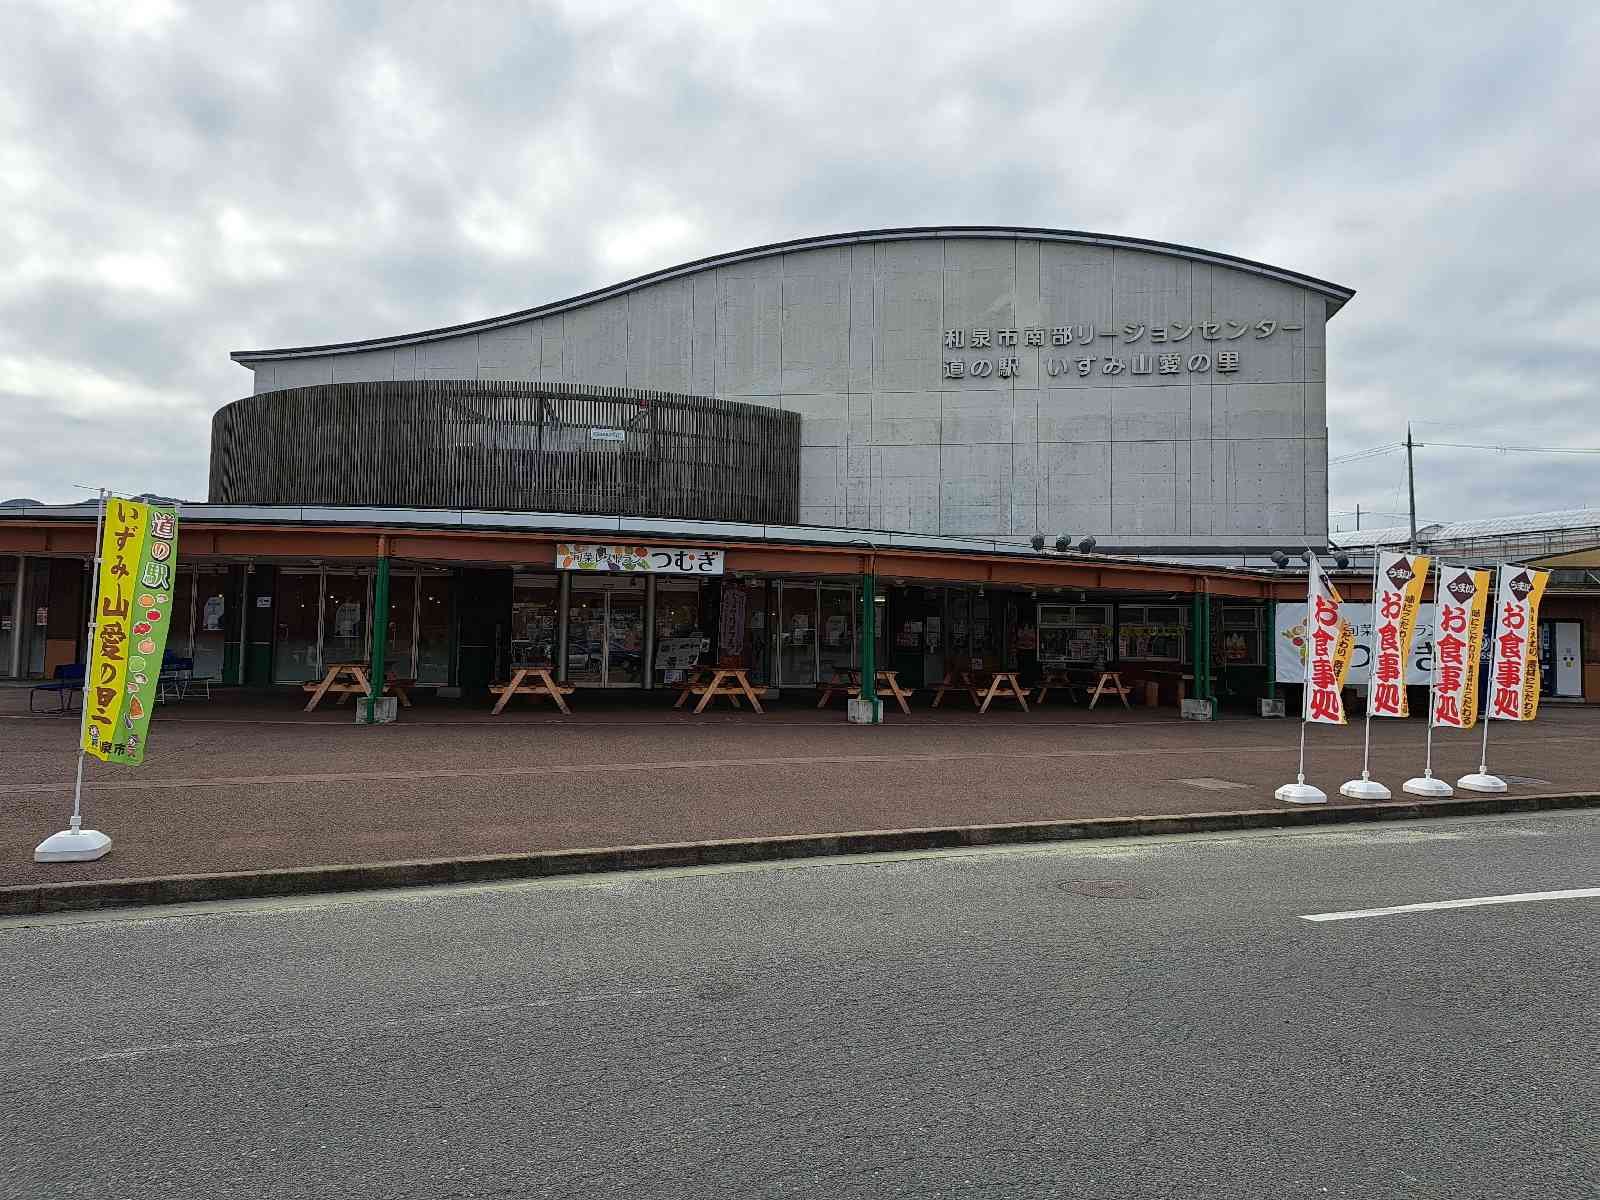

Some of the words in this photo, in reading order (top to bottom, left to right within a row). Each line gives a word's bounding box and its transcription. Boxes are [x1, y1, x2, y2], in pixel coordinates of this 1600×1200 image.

[943, 357, 1020, 379] 道の駅
[944, 321, 1303, 348] 和泉市南部リージョンセンター
[142, 511, 176, 590] 道の駅
[651, 550, 720, 572] つむぎ
[91, 502, 139, 725] いずみ山愛の里
[1310, 594, 1340, 721] お食事処
[1375, 590, 1402, 714] お食事処
[1435, 603, 1467, 726] お食事処
[1494, 600, 1525, 719] お食事処
